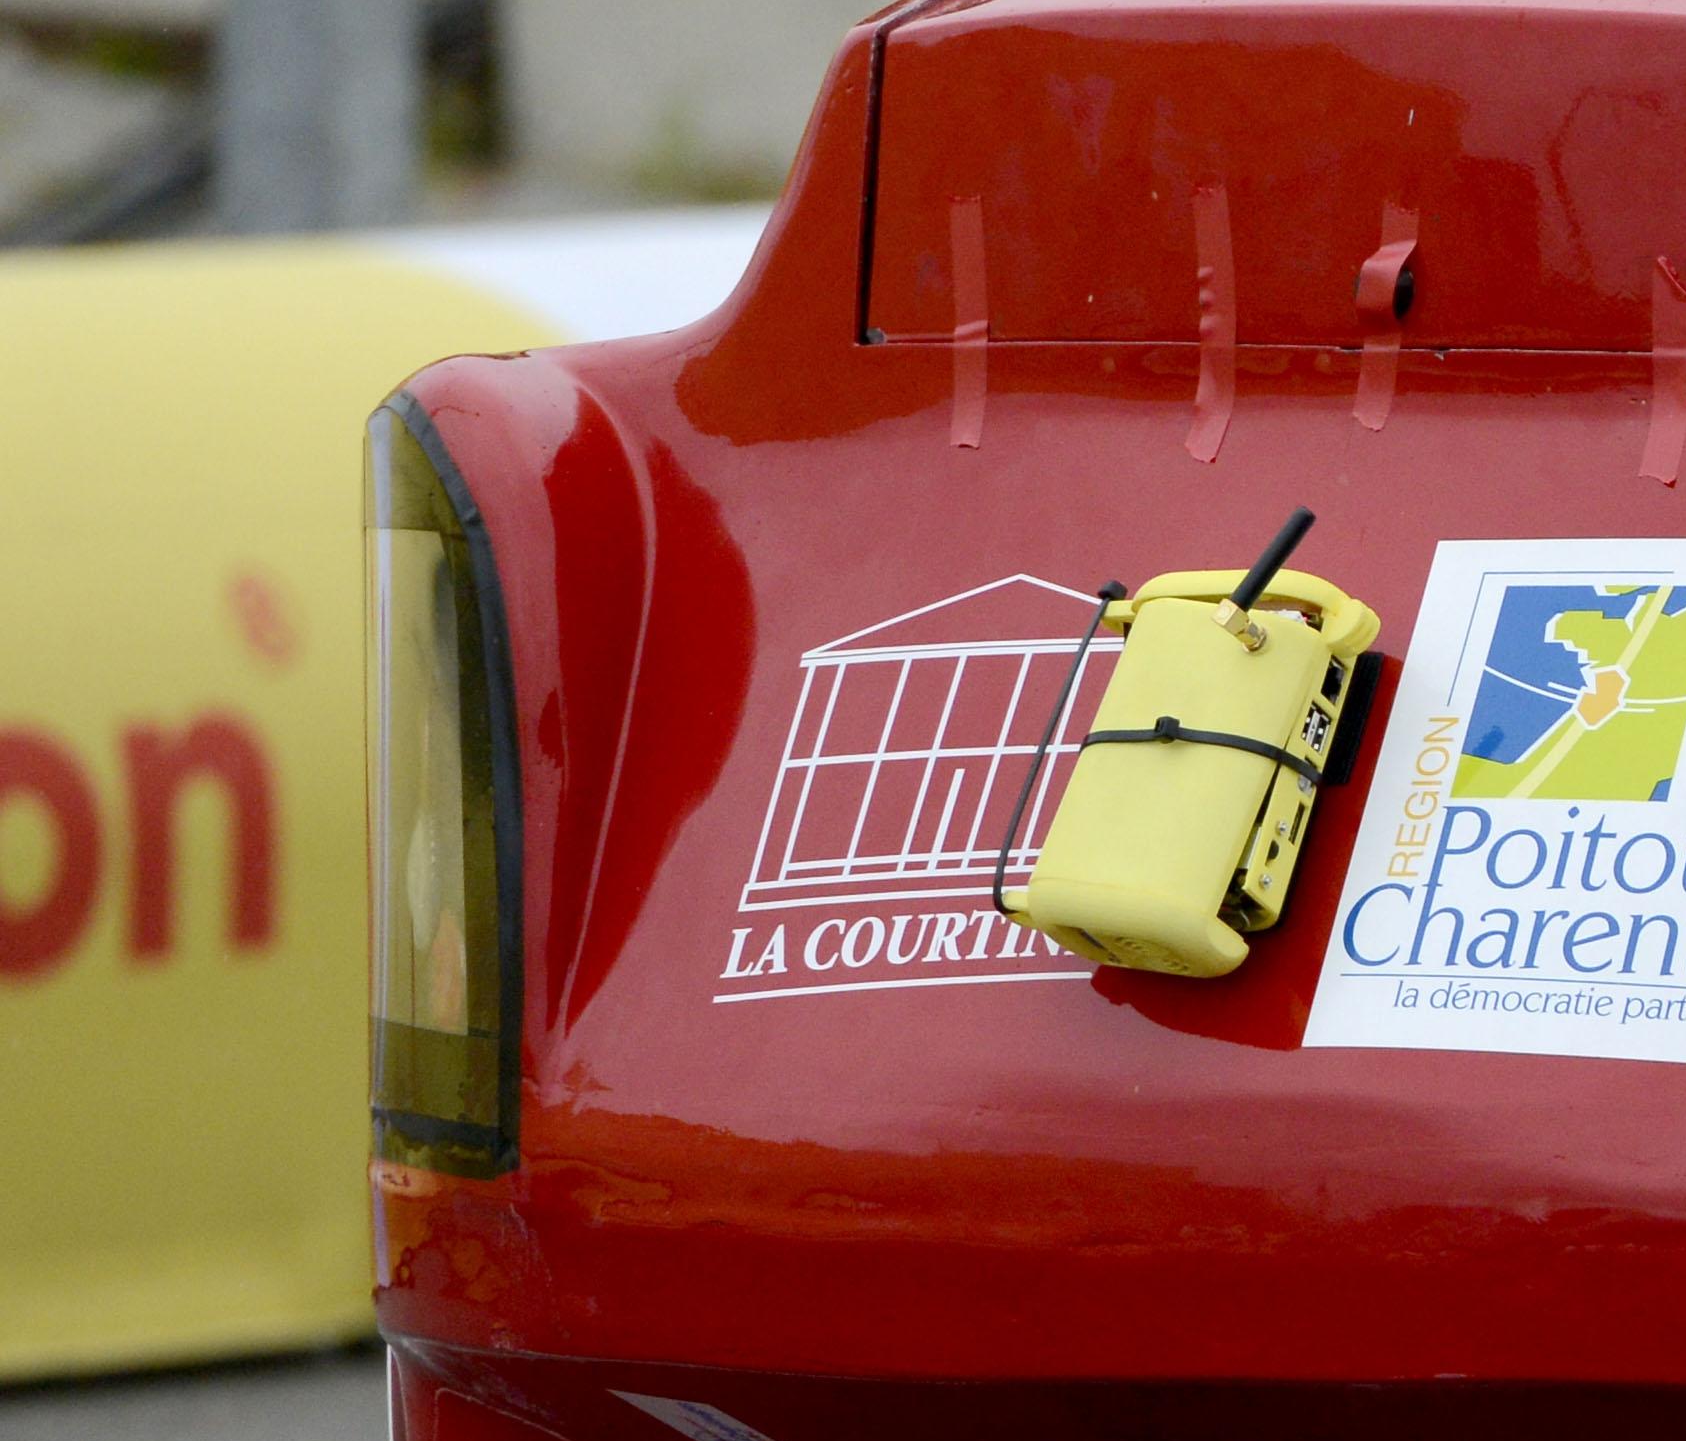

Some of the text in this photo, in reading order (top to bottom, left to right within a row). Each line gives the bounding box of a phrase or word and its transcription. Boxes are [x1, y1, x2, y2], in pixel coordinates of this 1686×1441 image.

[1387, 716, 1459, 877] REGION
[720, 924, 787, 979] LA
[1393, 981, 1419, 1009] la
[1430, 982, 1613, 1017] démocratie
